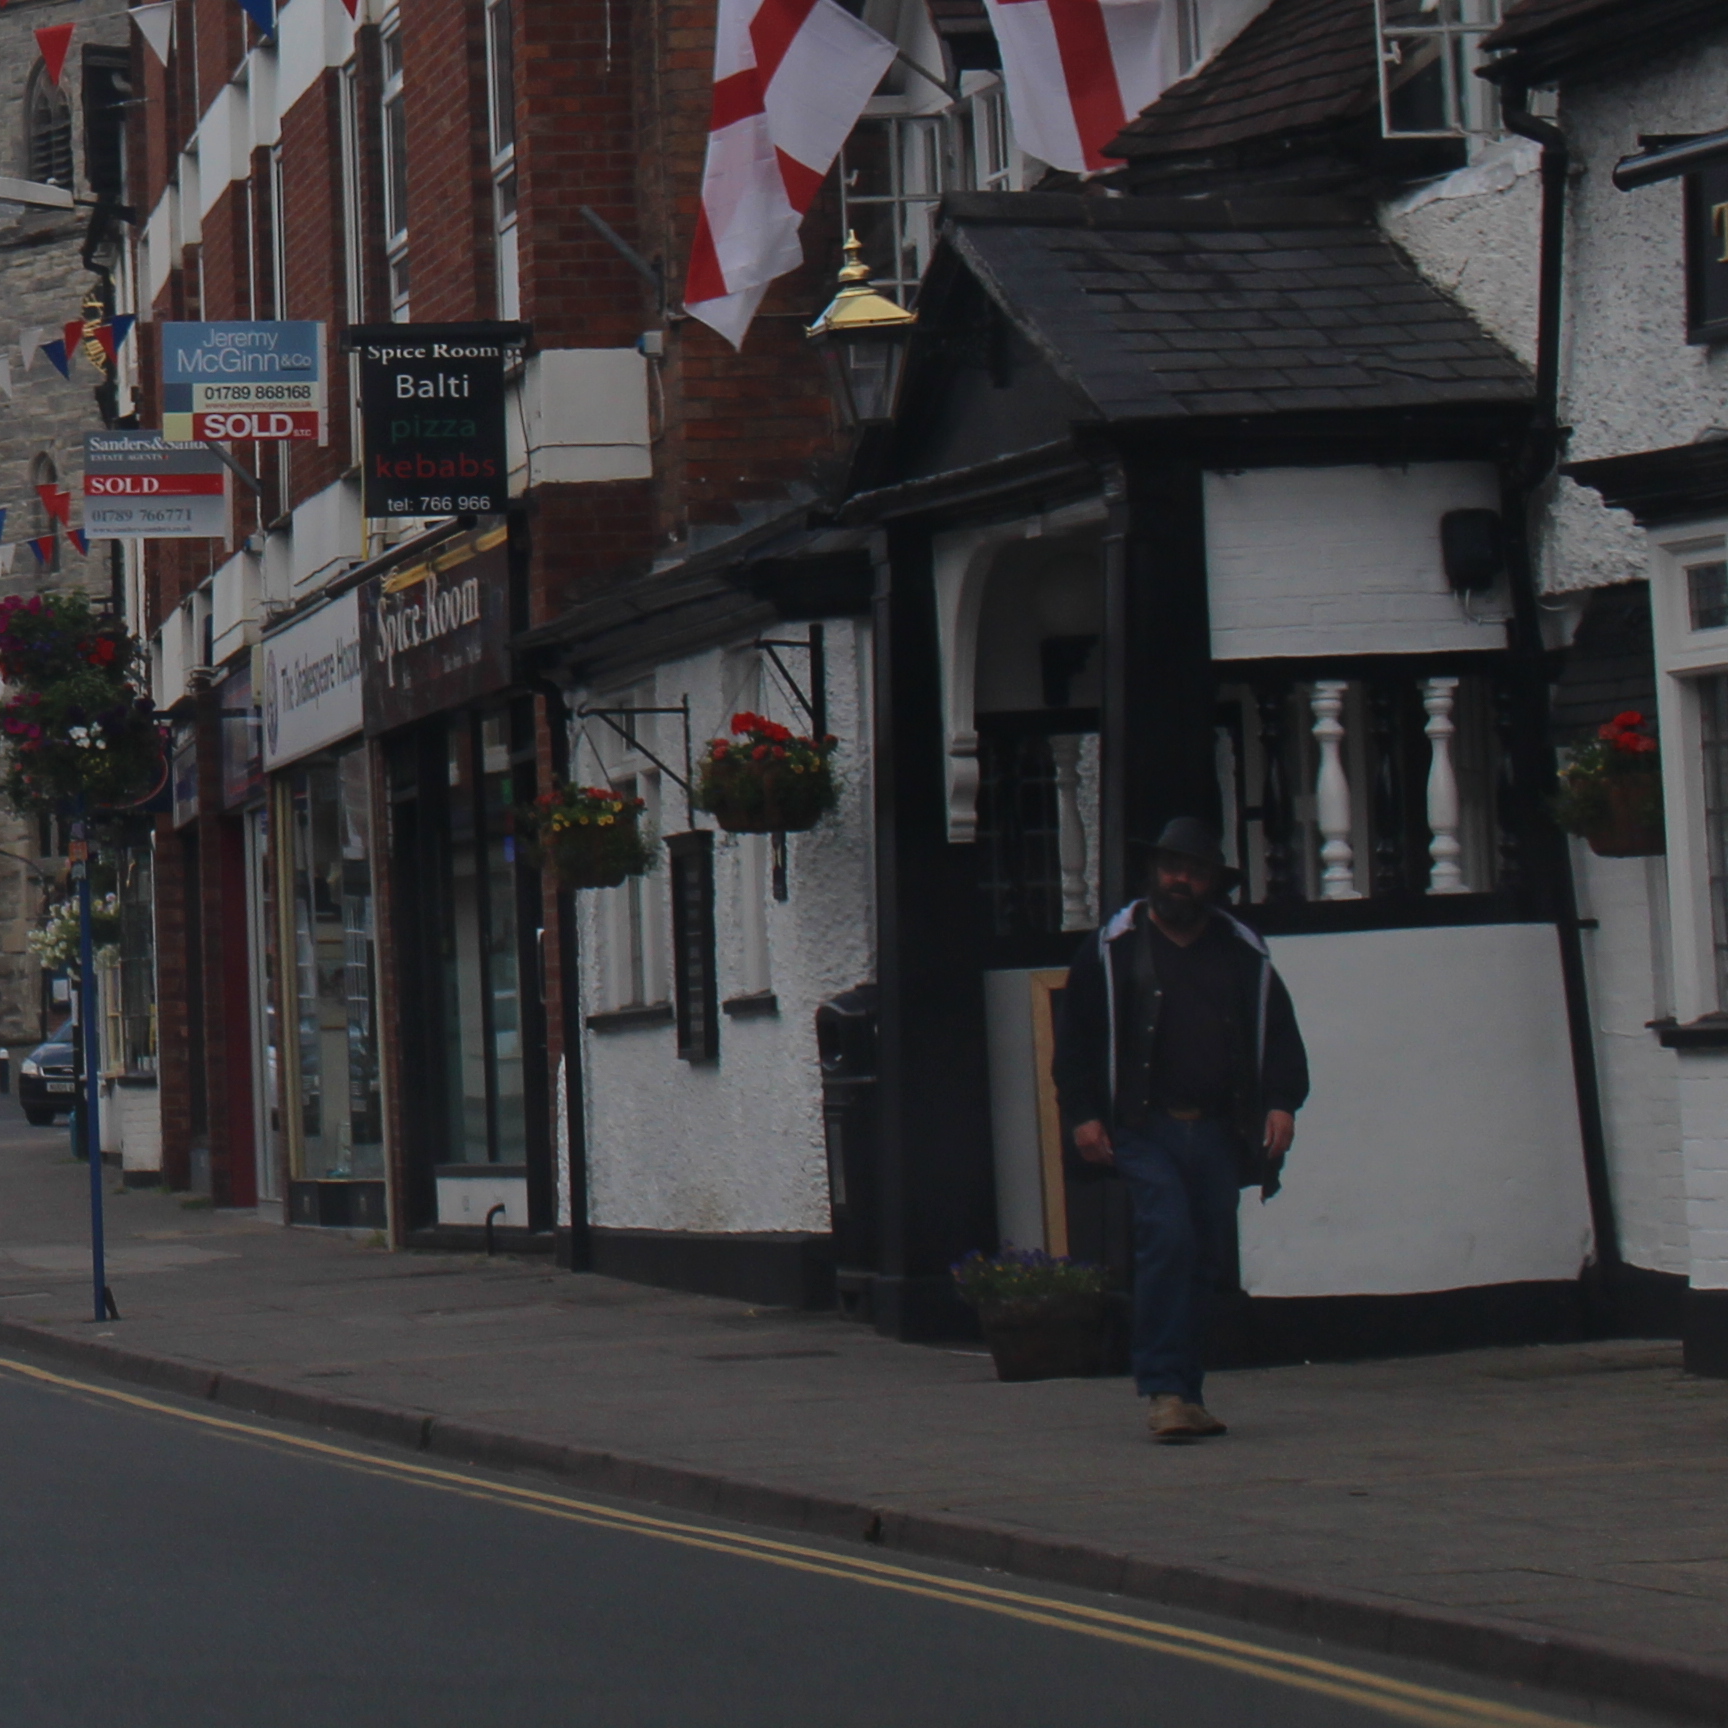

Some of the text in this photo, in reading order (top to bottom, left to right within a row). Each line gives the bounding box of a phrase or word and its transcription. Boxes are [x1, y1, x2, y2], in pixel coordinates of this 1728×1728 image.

[203, 328, 278, 351] Jeremy
[178, 348, 280, 373] McGinn
[368, 344, 499, 365] Spice Room
[205, 386, 311, 400] 01789 868168
[396, 373, 469, 399] Balti
[204, 413, 293, 438] SOLD
[391, 415, 476, 444] pizza
[128, 453, 163, 461] AGENTS
[376, 453, 496, 478] kebabs
[90, 477, 159, 494] SOLD
[91, 508, 192, 522] 01789 766771
[388, 496, 490, 511] tel: 766 966
[376, 596, 422, 688] Spice
[425, 570, 480, 642] Room
[281, 666, 294, 712] The
[295, 652, 334, 711] Shakespeare
